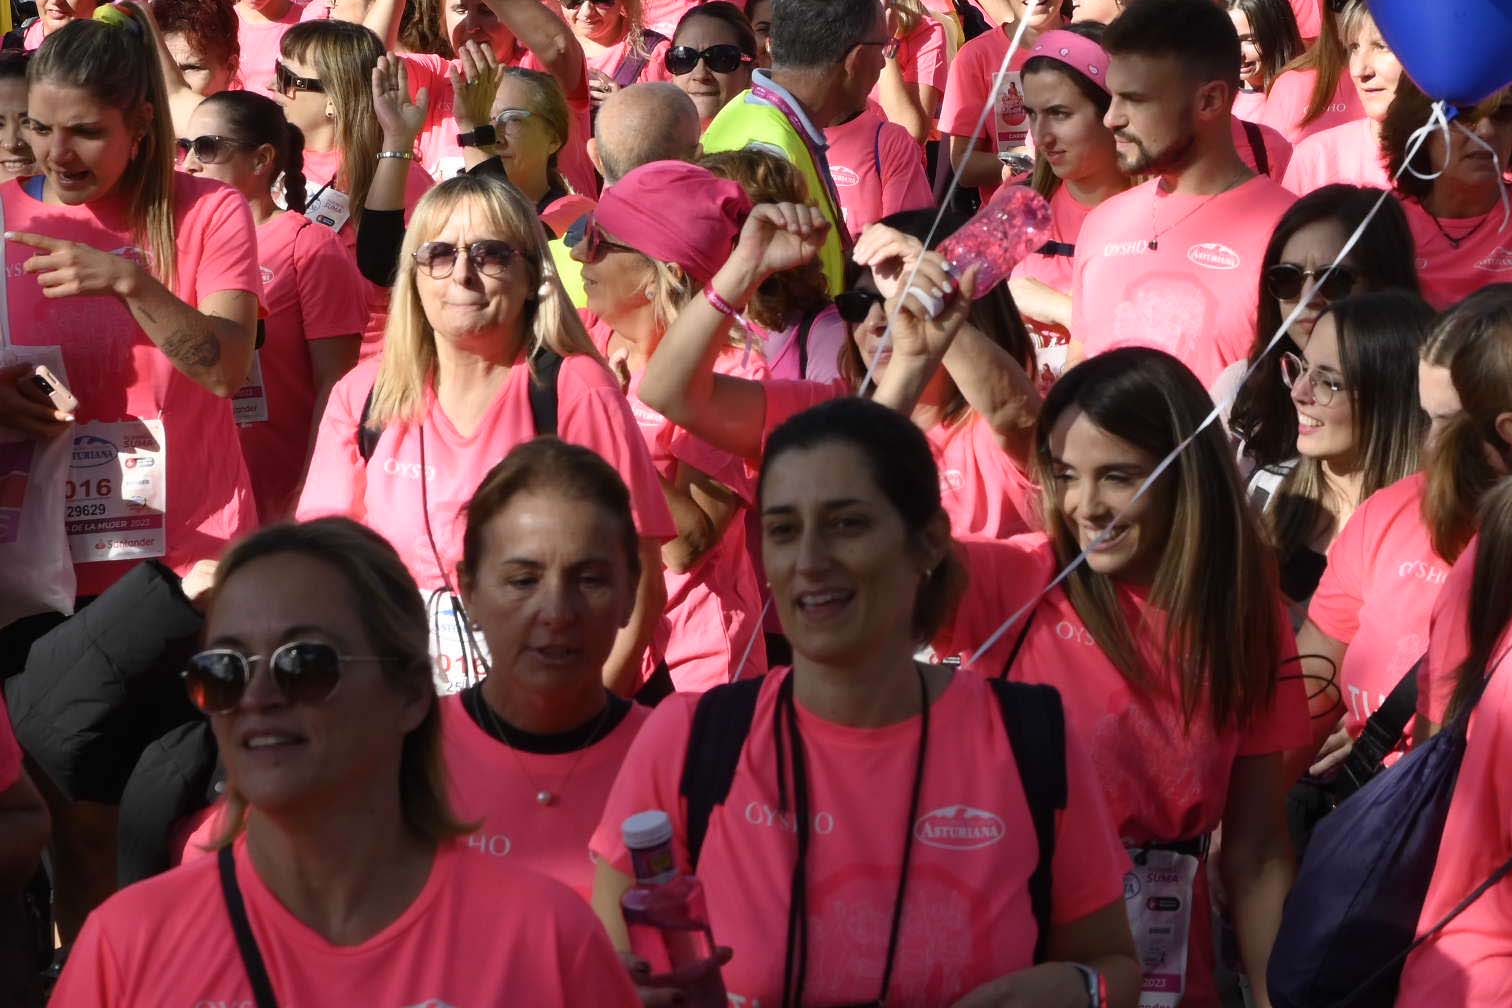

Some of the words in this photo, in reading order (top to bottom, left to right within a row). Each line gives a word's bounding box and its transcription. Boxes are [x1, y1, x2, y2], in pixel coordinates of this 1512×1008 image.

[107, 538, 155, 549] Santander
[1056, 620, 1095, 647] OYS
[921, 822, 999, 840] ASTURIANA
[1143, 978, 1168, 988] 2023
